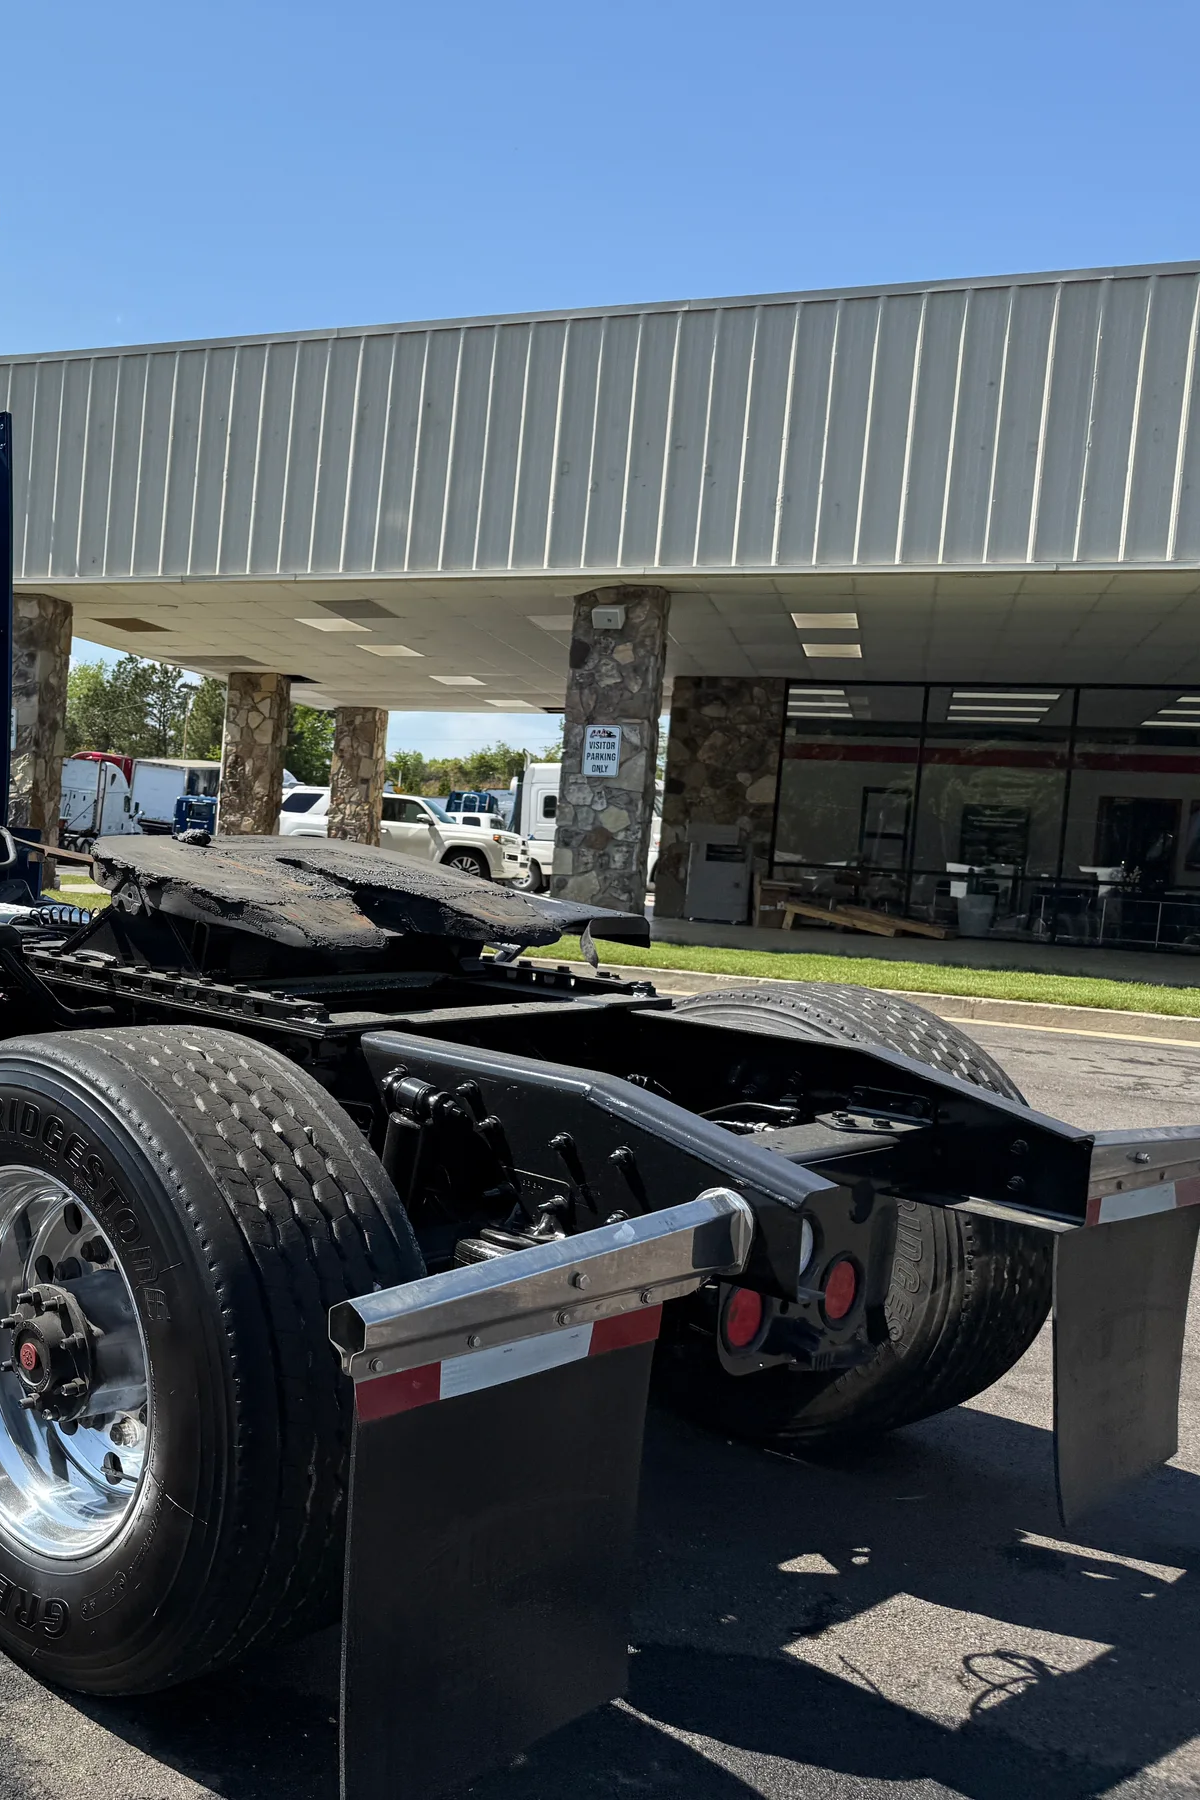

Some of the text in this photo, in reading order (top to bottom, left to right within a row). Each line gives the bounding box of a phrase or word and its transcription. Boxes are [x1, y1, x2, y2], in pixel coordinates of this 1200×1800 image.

[589, 741, 615, 749] VISITOR
[586, 752, 616, 761] PARKING
[591, 764, 608, 773] ONLY
